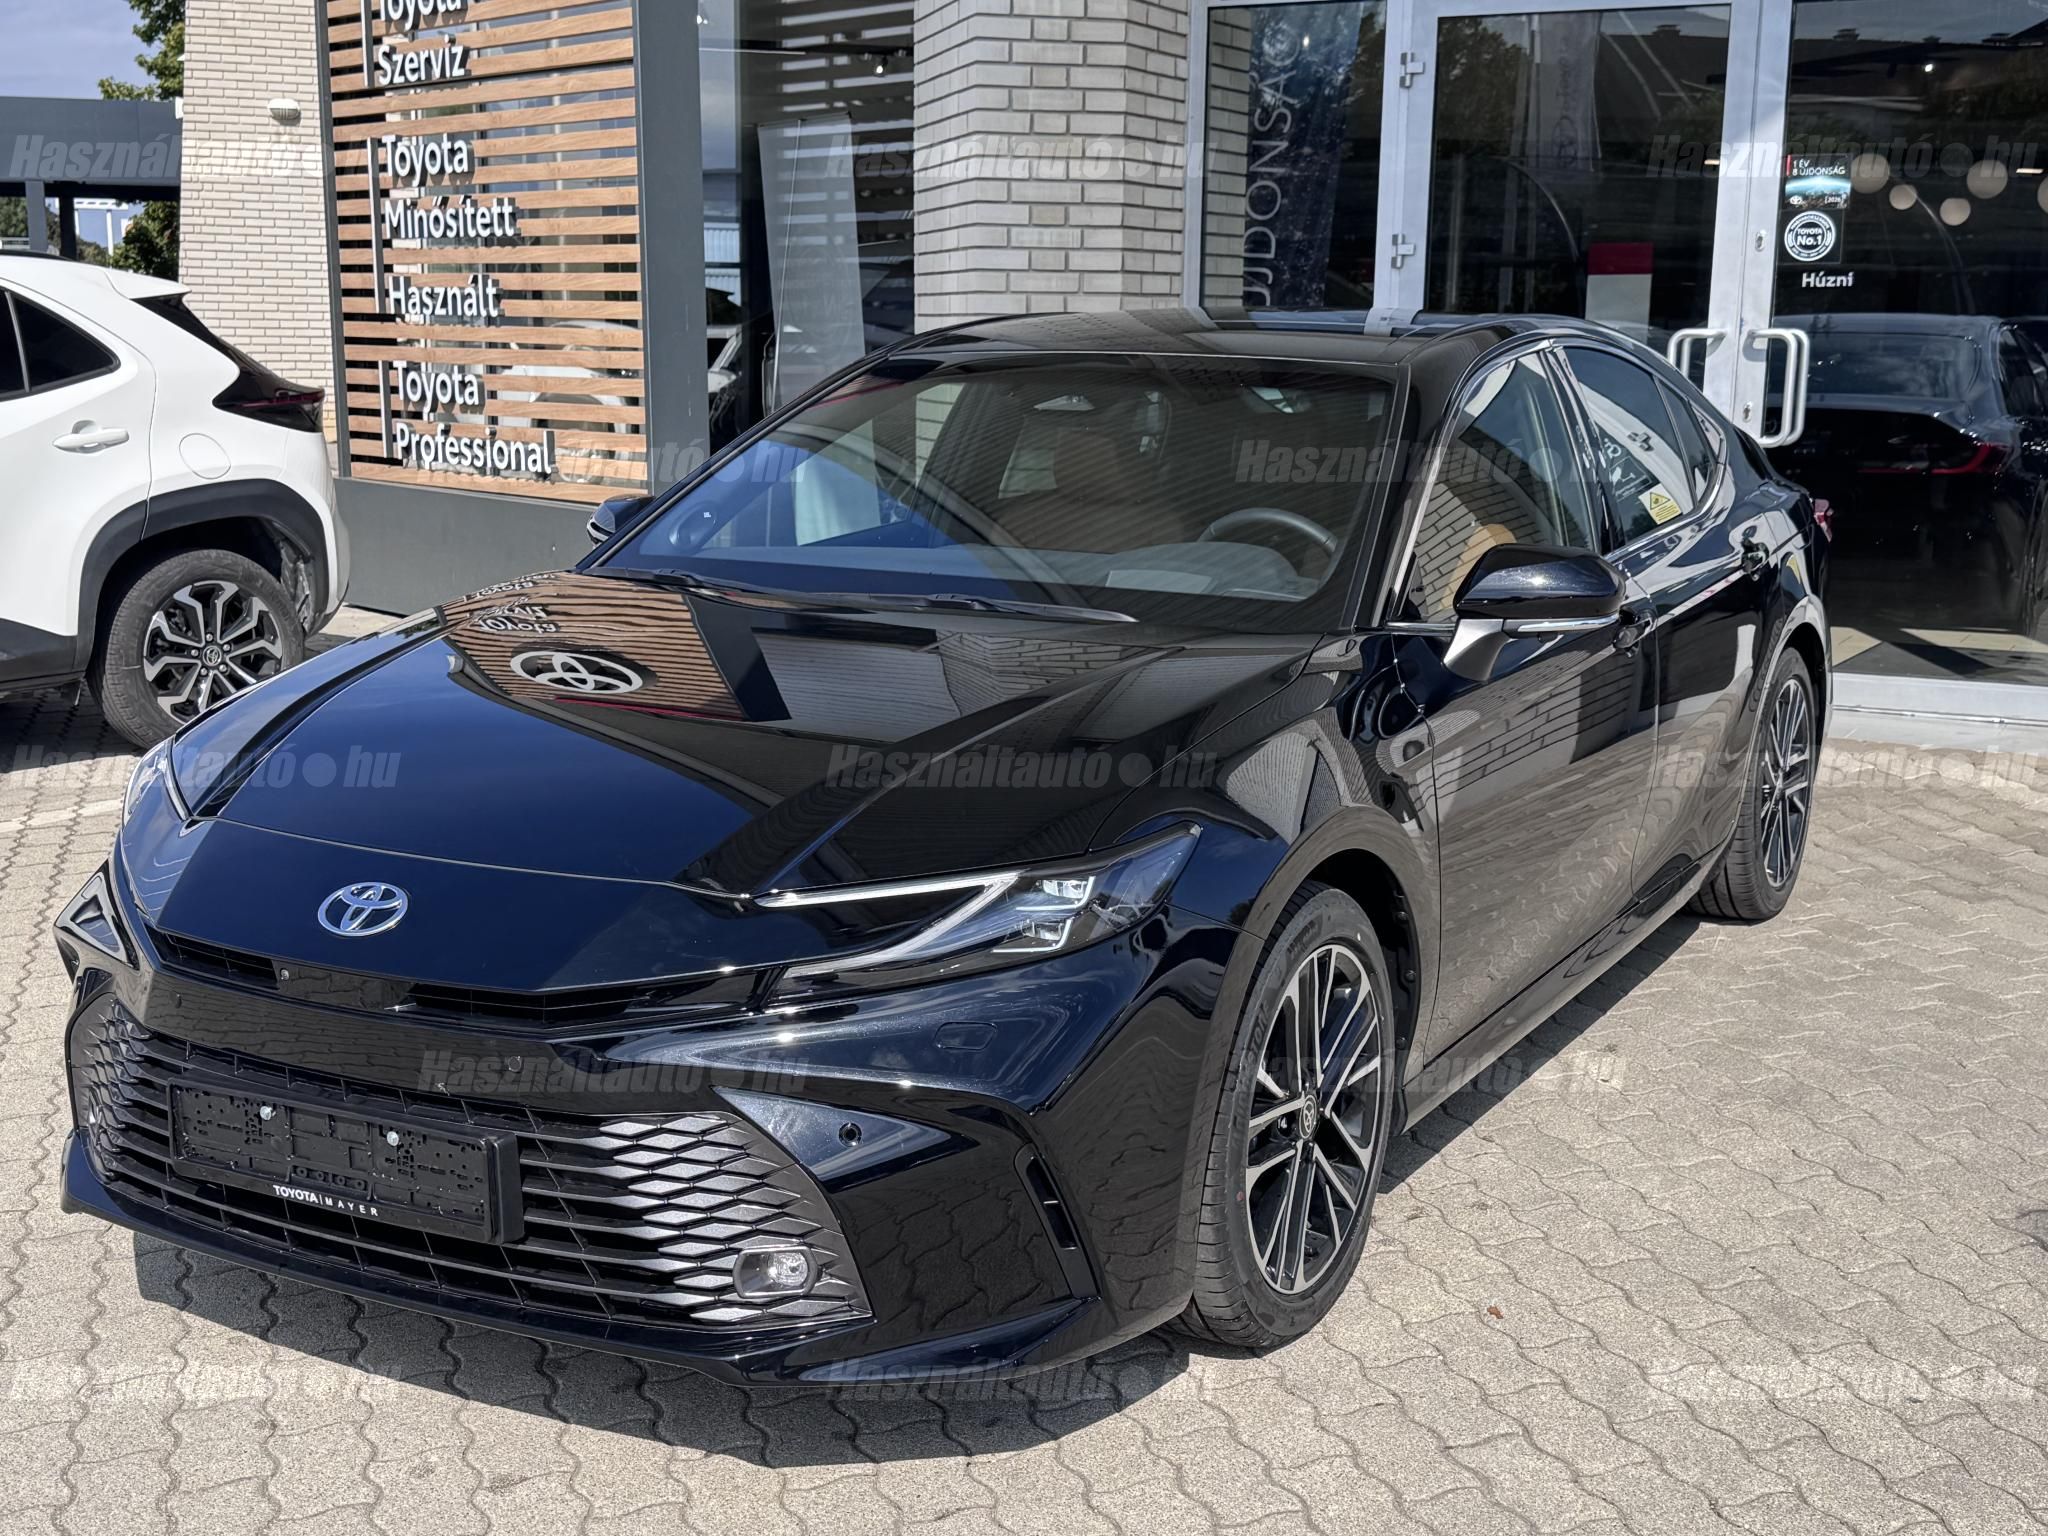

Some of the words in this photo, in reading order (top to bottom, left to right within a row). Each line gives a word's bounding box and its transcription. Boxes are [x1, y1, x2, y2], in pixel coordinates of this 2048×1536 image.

[378, 34, 465, 86] Szerviz
[382, 133, 470, 187] Toyota
[1792, 168, 1798, 176] 8
[1799, 158, 1811, 168] ÉV
[385, 195, 515, 239] Minősített
[1797, 235, 1822, 246] No.1
[389, 273, 499, 318] Használt
[393, 360, 480, 421] Toyota
[396, 422, 552, 474] Professional
[273, 1184, 319, 1204] TOYOTA
[325, 1196, 378, 1216] MAYER
